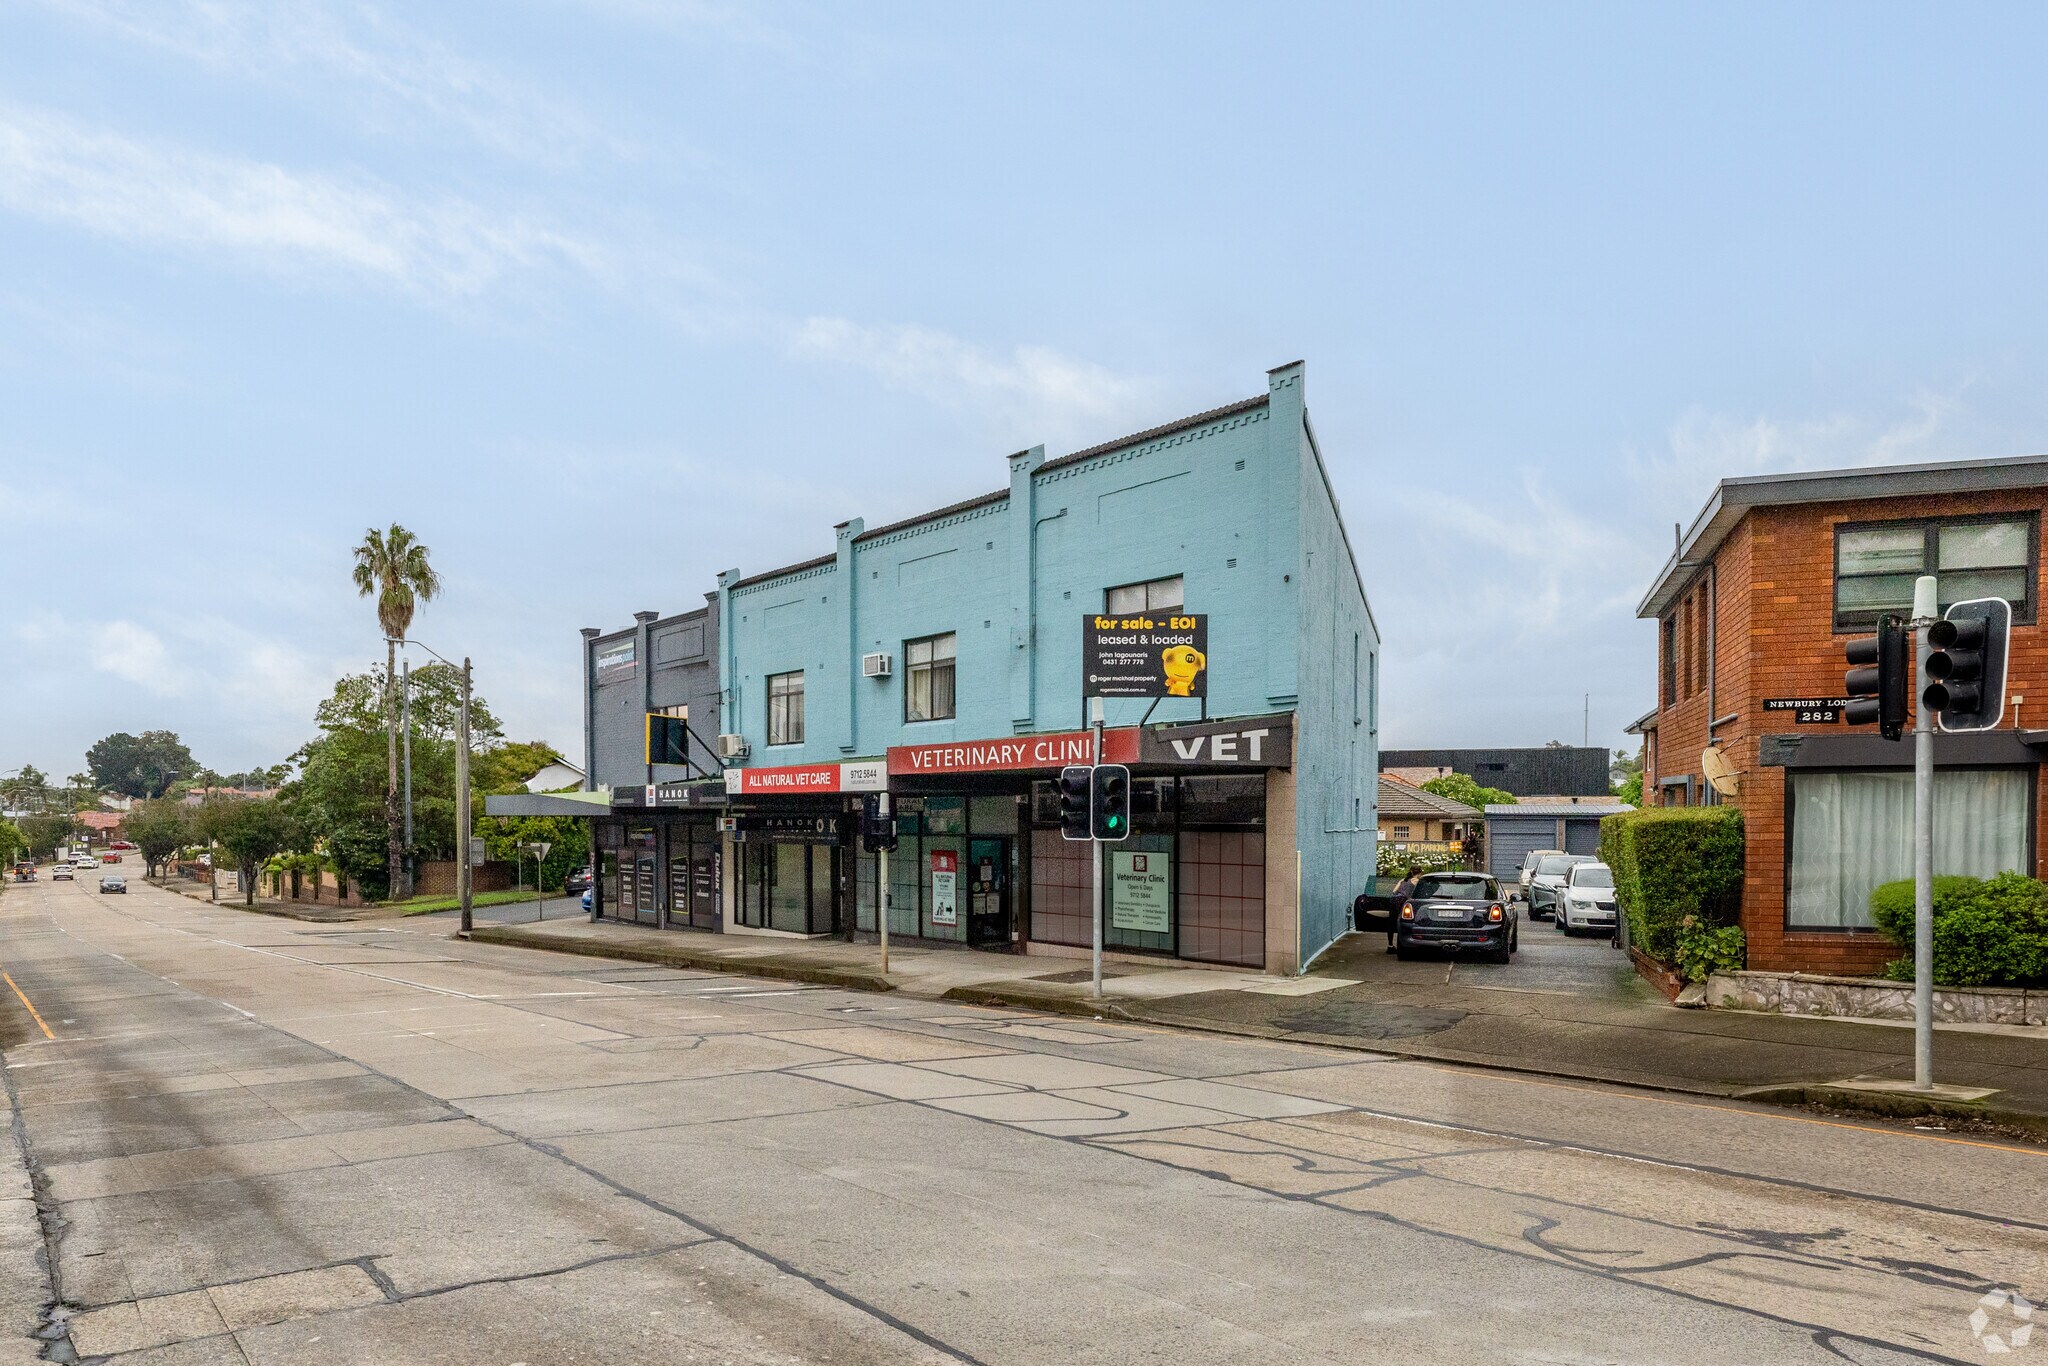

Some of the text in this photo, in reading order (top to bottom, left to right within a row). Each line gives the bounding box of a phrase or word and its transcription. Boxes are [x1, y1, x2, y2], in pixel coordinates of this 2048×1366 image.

[1095, 616, 1117, 630] for
[1121, 616, 1153, 630] sale
[1170, 617, 1196, 630] EOI
[1098, 635, 1193, 645] leased & loaded
[1770, 700, 1822, 708] NEWBURY
[1802, 712, 1833, 721] 282
[1171, 728, 1269, 761] VET
[911, 744, 1026, 768] VETERINARY
[749, 772, 831, 786] ALL NATURAL VET CARE
[850, 769, 877, 779] 9712 5844
[659, 789, 689, 798] HANOK
[1116, 873, 1165, 883] Veterinary Clinic
